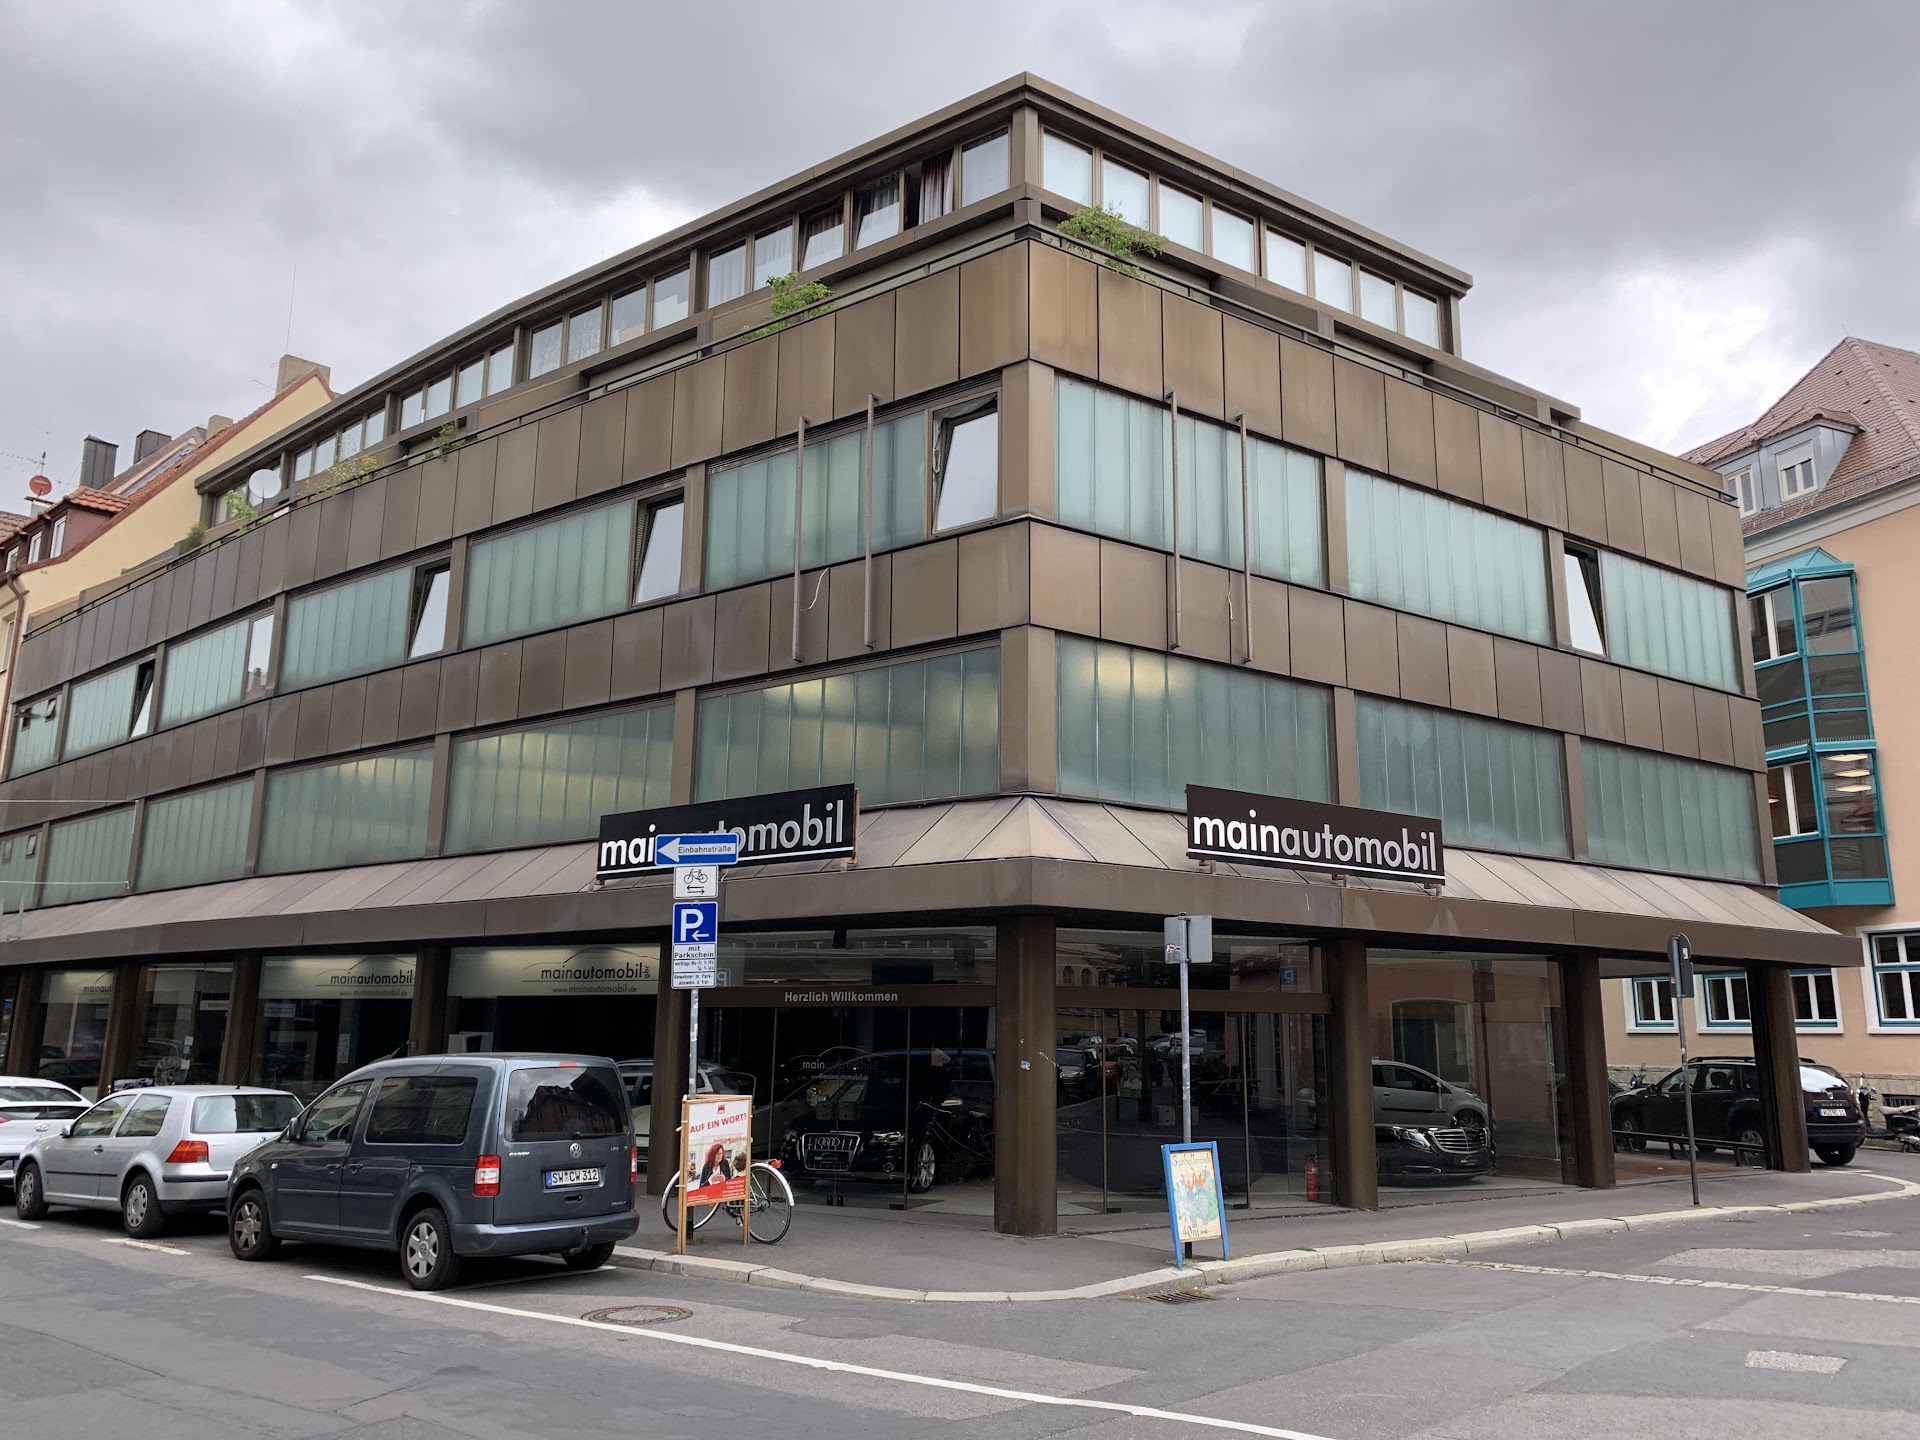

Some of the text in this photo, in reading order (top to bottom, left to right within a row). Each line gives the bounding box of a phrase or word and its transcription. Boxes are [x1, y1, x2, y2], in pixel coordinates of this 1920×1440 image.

[601, 800, 844, 867] maiomobil
[1193, 809, 1437, 871] mainautomobil
[678, 845, 732, 853] Einbahnstraße
[680, 908, 704, 941] P
[330, 970, 412, 985] mainautomobil
[541, 962, 643, 979] mainautomobil
[553, 983, 637, 993] www.mainautomobil.de
[784, 991, 898, 1002] Herzlich Willkommen
[690, 1112, 747, 1134] AUF EIN WORT!
[552, 1169, 598, 1184] SW CW 312
